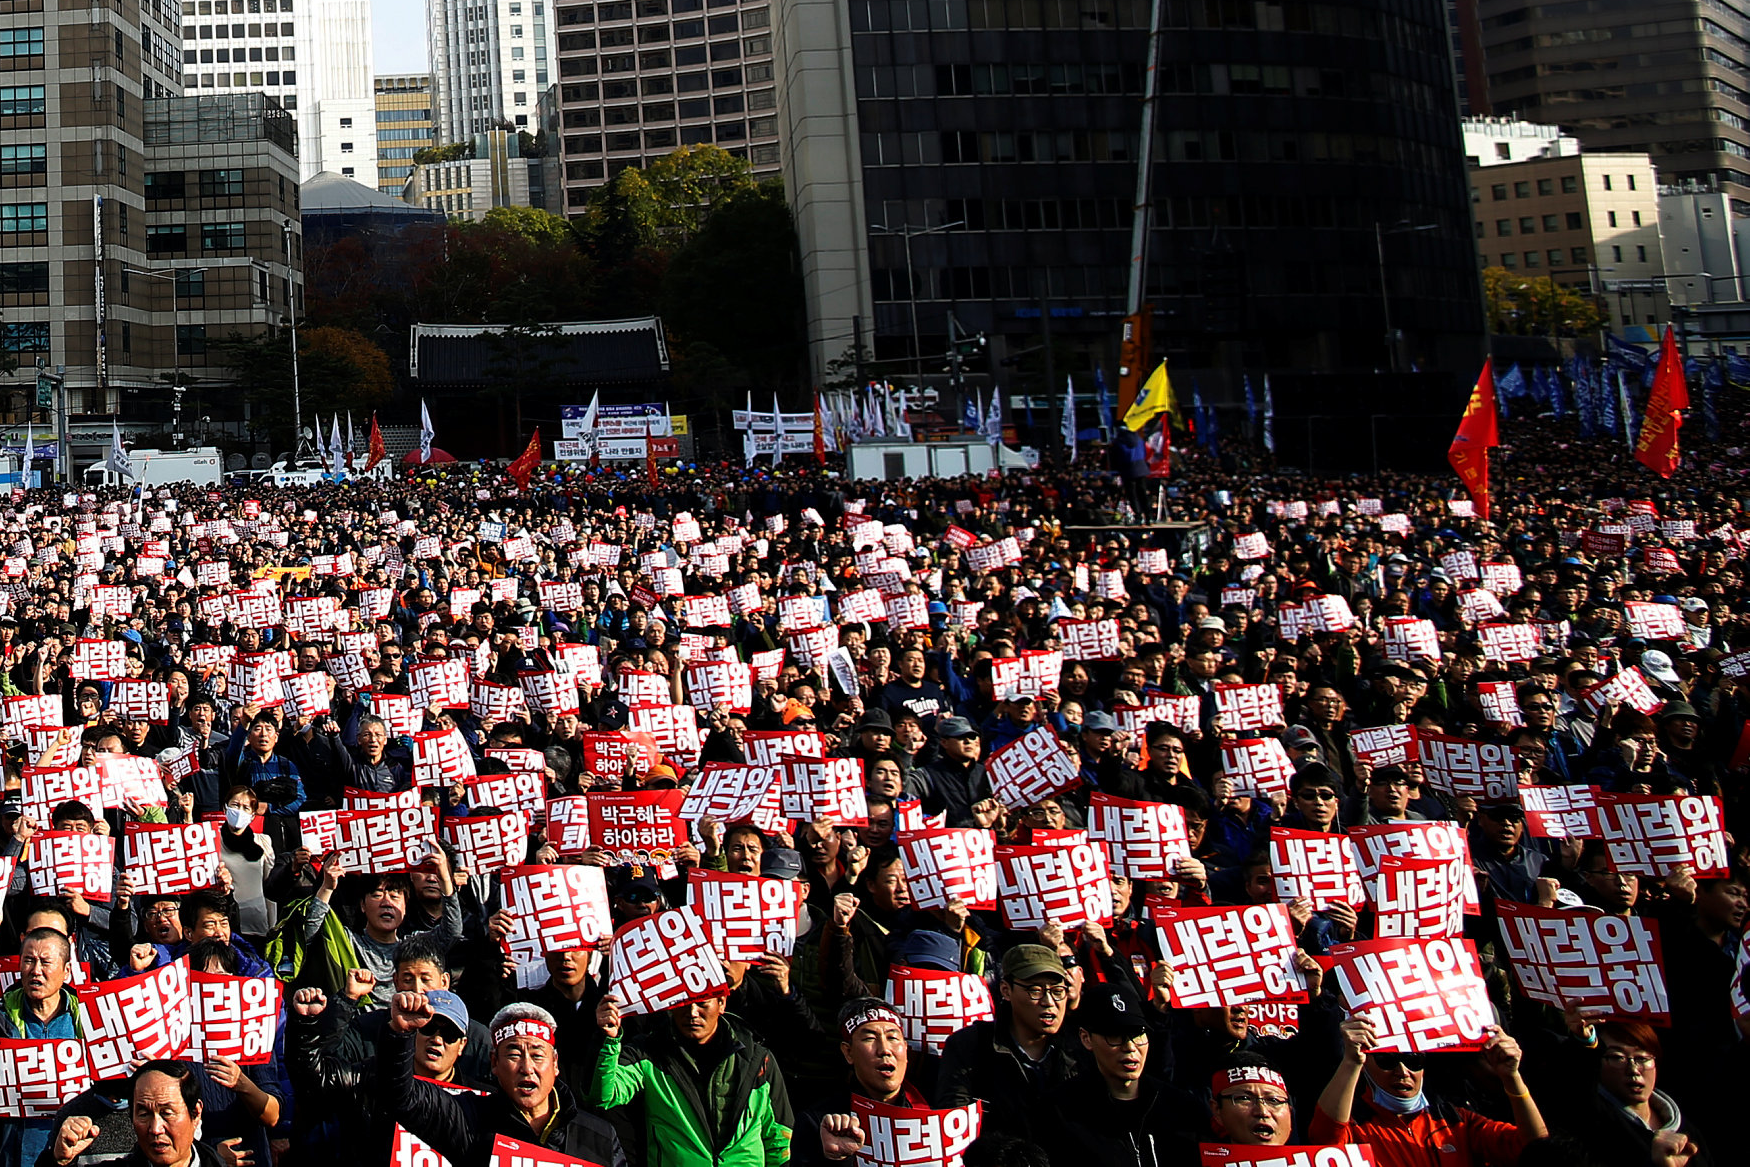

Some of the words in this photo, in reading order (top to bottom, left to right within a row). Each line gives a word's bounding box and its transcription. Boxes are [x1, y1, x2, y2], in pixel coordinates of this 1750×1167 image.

[685, 595, 729, 615] 내려와
[1624, 602, 1683, 625] 내려와
[1059, 619, 1118, 645] 내려와
[1384, 620, 1436, 641] 내려와
[1477, 624, 1537, 645] 내려와
[71, 640, 127, 662] 내려와
[1062, 641, 1119, 660] 박근혜
[71, 659, 127, 679] 박근혜
[686, 661, 752, 692] 내려와
[110, 680, 170, 705] 내려와
[903, 698, 939, 712] Twins
[1215, 684, 1280, 712] 내려와
[1219, 706, 1282, 730] 박근혜
[1351, 724, 1412, 752] 재벌도
[487, 751, 544, 772] 박근혜
[780, 758, 863, 786] 내려와
[1369, 745, 1406, 767] 공범
[1418, 737, 1517, 776] 내려와
[22, 765, 102, 805] 내려와
[692, 765, 774, 797] 내려와
[1422, 766, 1519, 801] 박근혜
[679, 795, 762, 819] 박근혜
[781, 785, 868, 820] 박근혜
[1523, 784, 1596, 812] 재벌도
[335, 806, 435, 851] 내려와
[443, 810, 528, 851] 내려와
[601, 804, 672, 826] 박근혜는
[1088, 803, 1187, 842] 내려와
[1539, 812, 1590, 837] 공범
[1597, 796, 1721, 840] 내려와
[29, 833, 114, 871] 내려와
[124, 820, 218, 866] 내려와
[603, 826, 675, 849] 하야하라
[899, 828, 995, 878] 내려와
[1607, 831, 1728, 877] 박근혜
[124, 852, 219, 892] 박근혜
[997, 842, 1107, 895] 내려와
[500, 868, 606, 916] 내려와
[1377, 860, 1464, 912] 내려와
[610, 905, 709, 981] 내려와
[1156, 903, 1292, 969] 내려와
[1497, 914, 1654, 965] 내려와
[1172, 949, 1308, 1007] 박근혜
[1334, 938, 1477, 1009] 내려와
[1514, 960, 1669, 1016] 박근혜
[79, 957, 189, 1041] 내려와
[885, 974, 991, 1018] 내려와
[494, 1023, 516, 1044] 단결
[1362, 983, 1495, 1053] 박근혜
[1227, 1066, 1261, 1083] 단결
